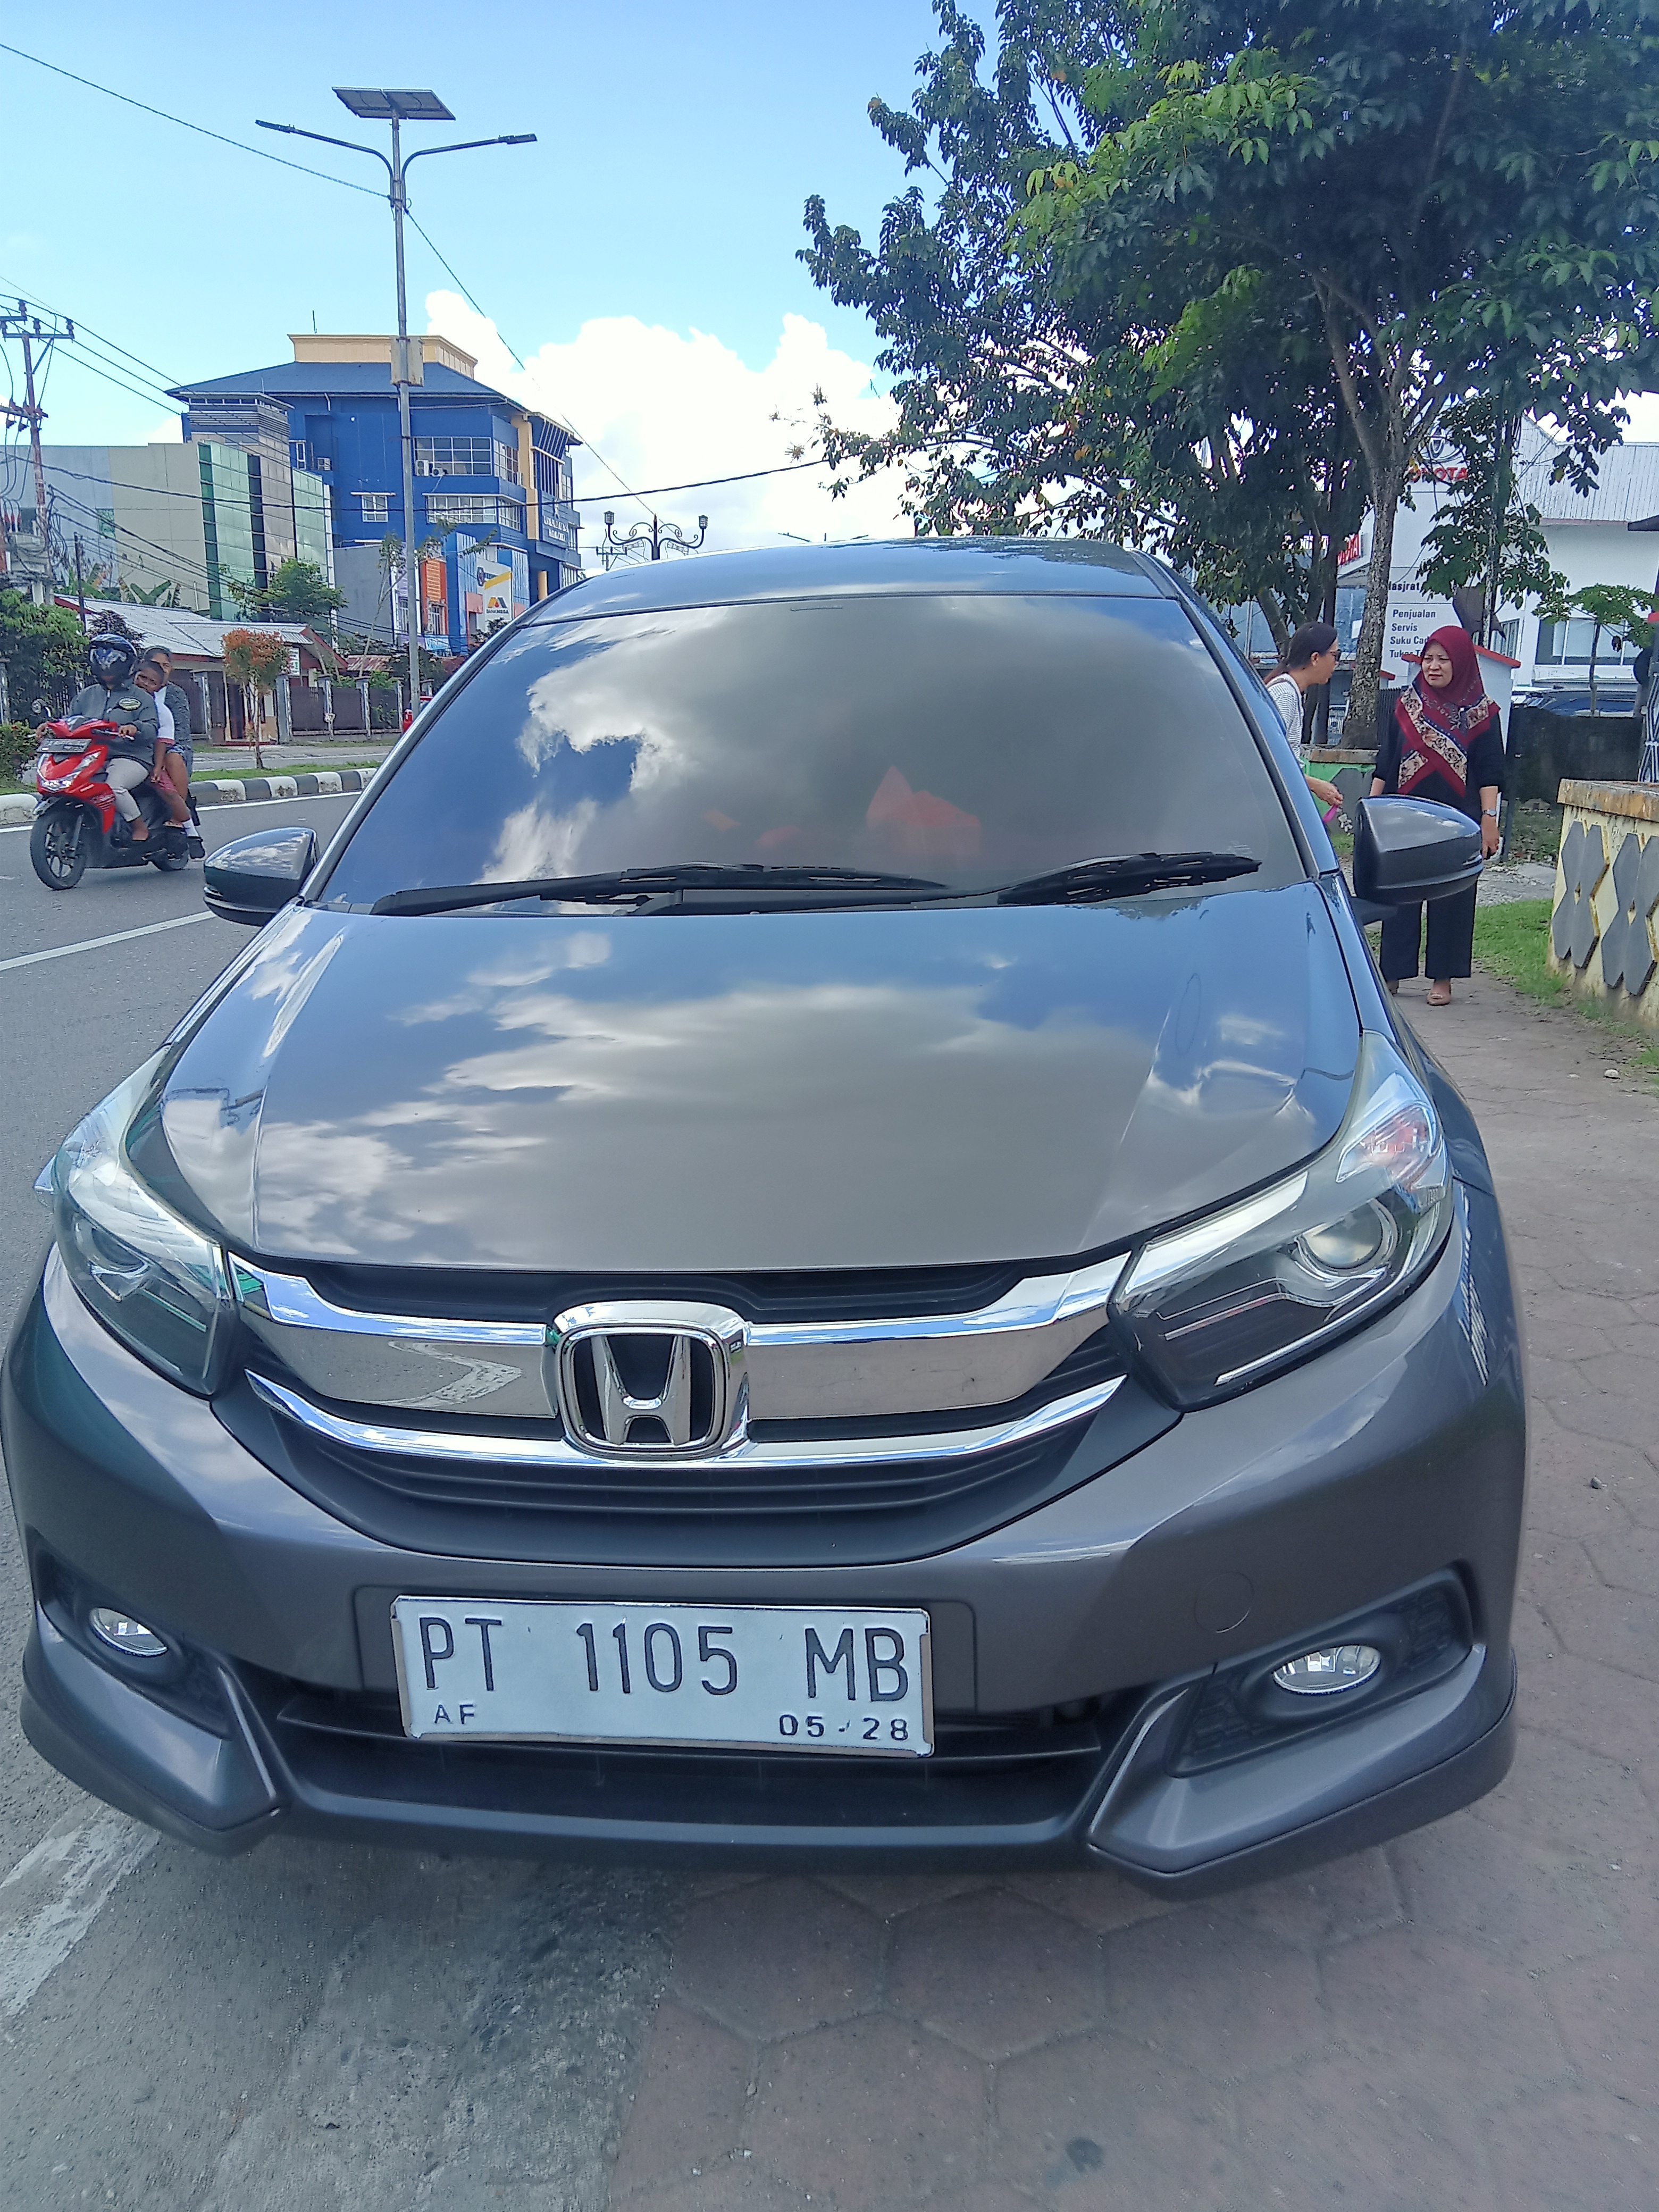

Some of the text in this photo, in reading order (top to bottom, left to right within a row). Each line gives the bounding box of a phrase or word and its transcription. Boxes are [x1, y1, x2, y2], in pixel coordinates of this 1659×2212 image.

[1404, 467, 1468, 481] OOTA
[1388, 581, 1420, 592] asjrat
[1393, 609, 1436, 619] Penjualan
[1391, 623, 1418, 631] Servis
[1389, 636, 1411, 644] Suku
[419, 1617, 908, 1702] PT 1105 MB
[434, 1704, 475, 1725] AF
